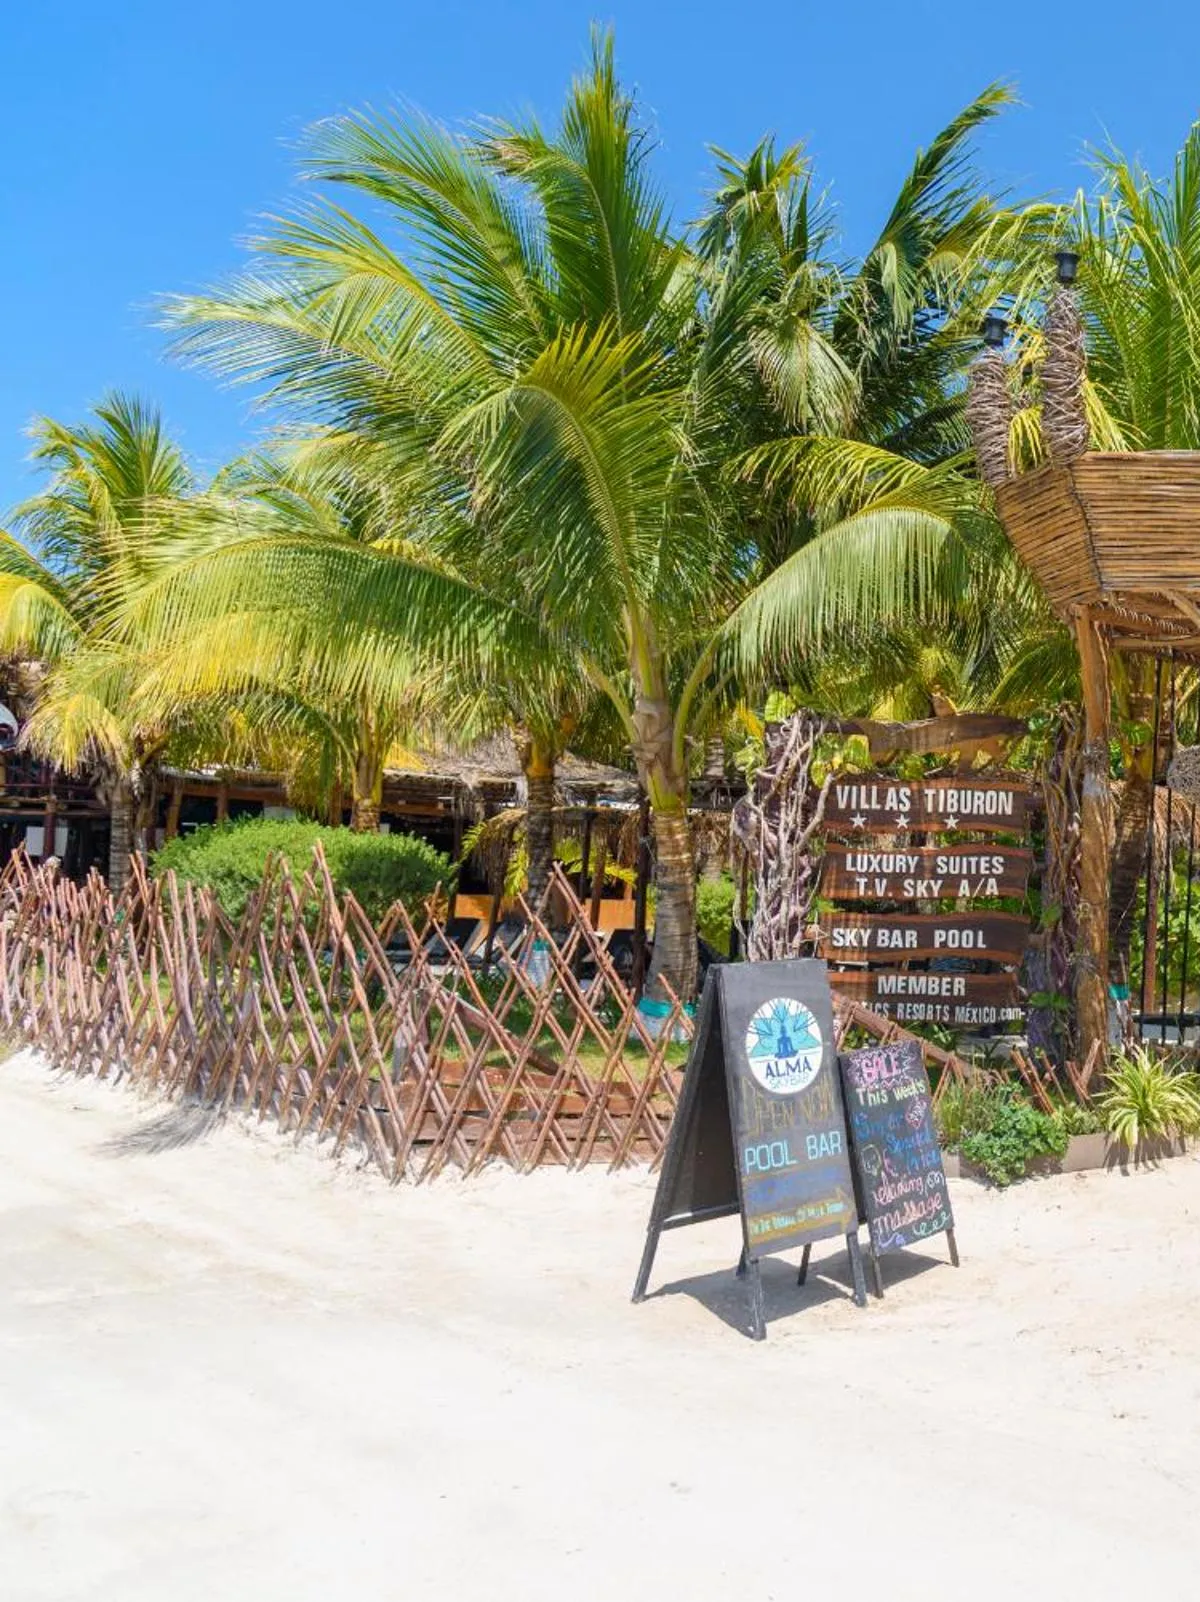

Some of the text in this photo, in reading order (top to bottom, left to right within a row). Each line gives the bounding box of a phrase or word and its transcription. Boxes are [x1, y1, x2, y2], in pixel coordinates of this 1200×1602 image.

[836, 785, 1013, 816] VILLAS TIBURON
[845, 853, 1005, 875] LUXURY SUITES
[855, 877, 1000, 898] T.V. SKY A/A
[933, 929, 987, 949] POOL
[877, 974, 966, 996] MEMBER
[896, 1002, 950, 1022] RESORTS
[765, 1056, 812, 1079] ALMA
[855, 1085, 889, 1107] This
[744, 1130, 842, 1175] POOL BAR
